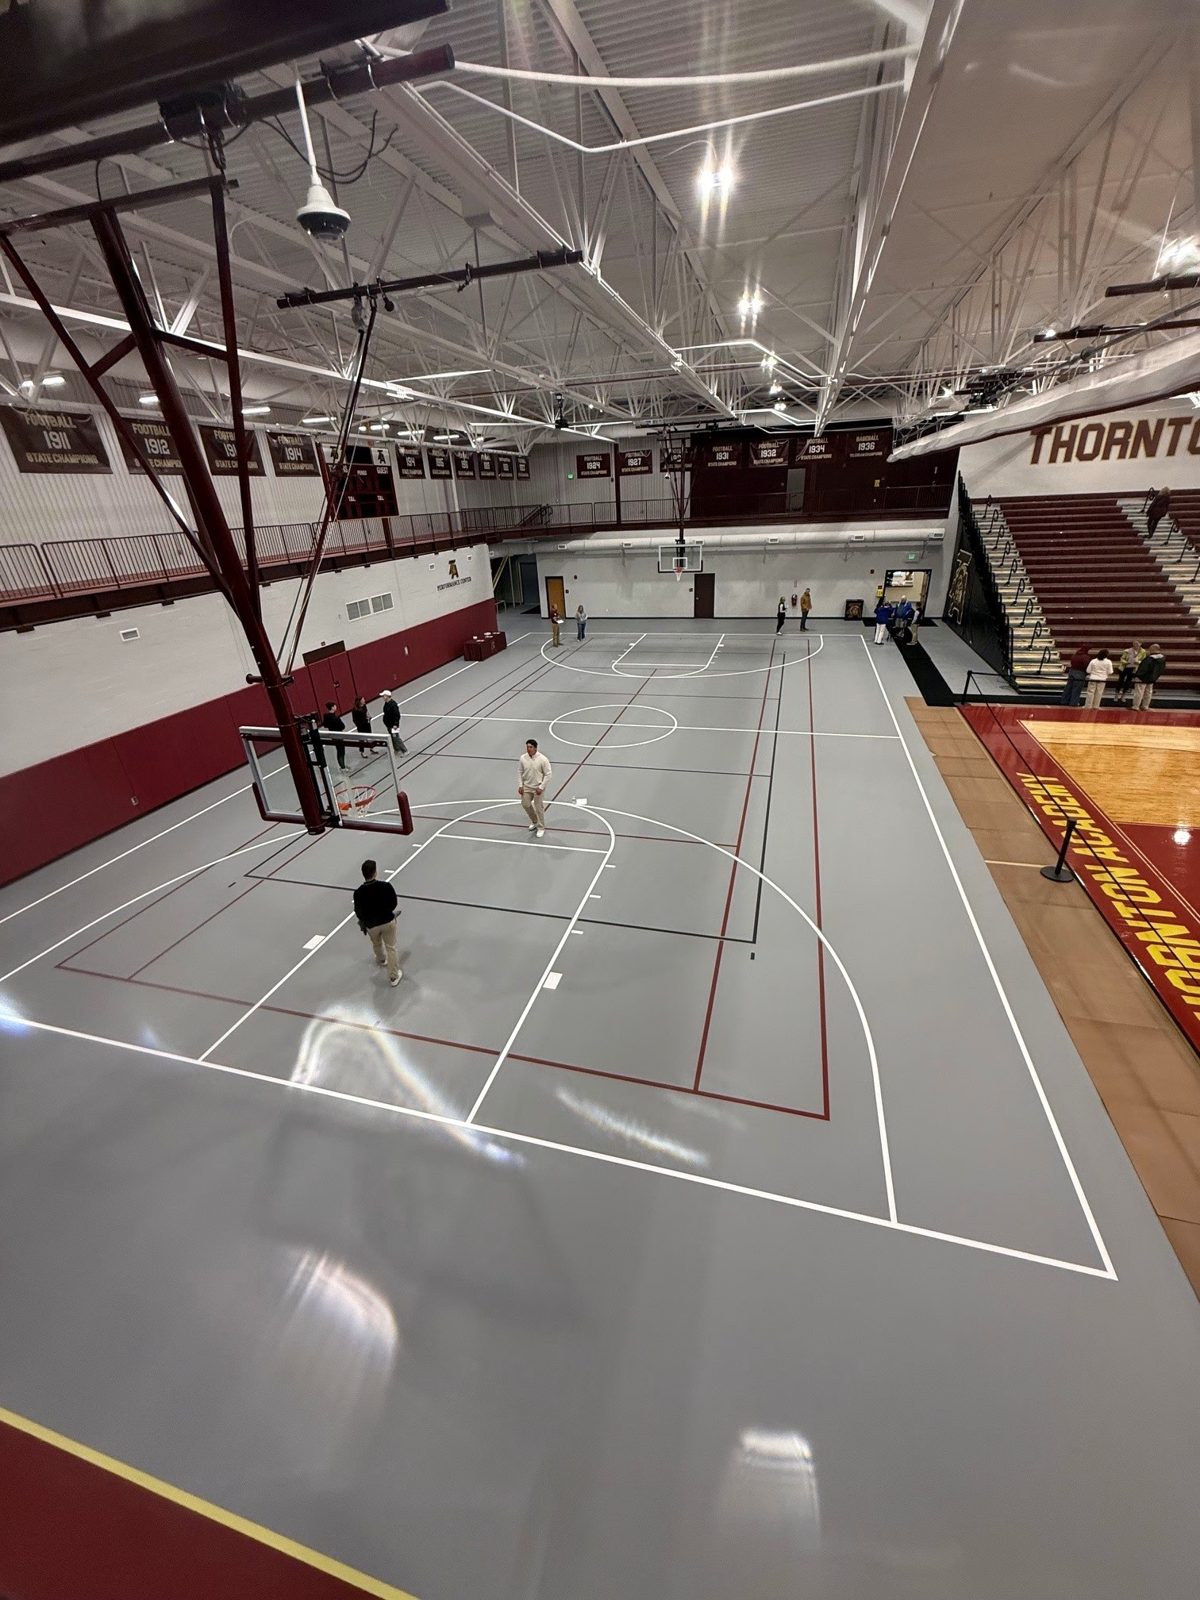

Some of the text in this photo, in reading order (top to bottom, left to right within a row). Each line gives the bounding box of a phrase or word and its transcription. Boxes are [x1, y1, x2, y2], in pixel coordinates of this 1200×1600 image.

[23, 412, 77, 429] FOOTBALL
[131, 423, 171, 436] FOOTBALL
[43, 430, 71, 449] 1911
[144, 438, 170, 455] 1912
[223, 443, 238, 457] 191
[808, 444, 826, 454] 1934
[857, 442, 875, 451] 1936
[26, 452, 99, 464] STATE CHAMPIONS
[285, 447, 303, 461] 1914
[716, 451, 729, 460] 1931
[760, 449, 777, 458] 1932
[627, 458, 641, 467] 1927
[376, 466, 389, 474] GUEST
[1016, 772, 1130, 863] ACADEMY
